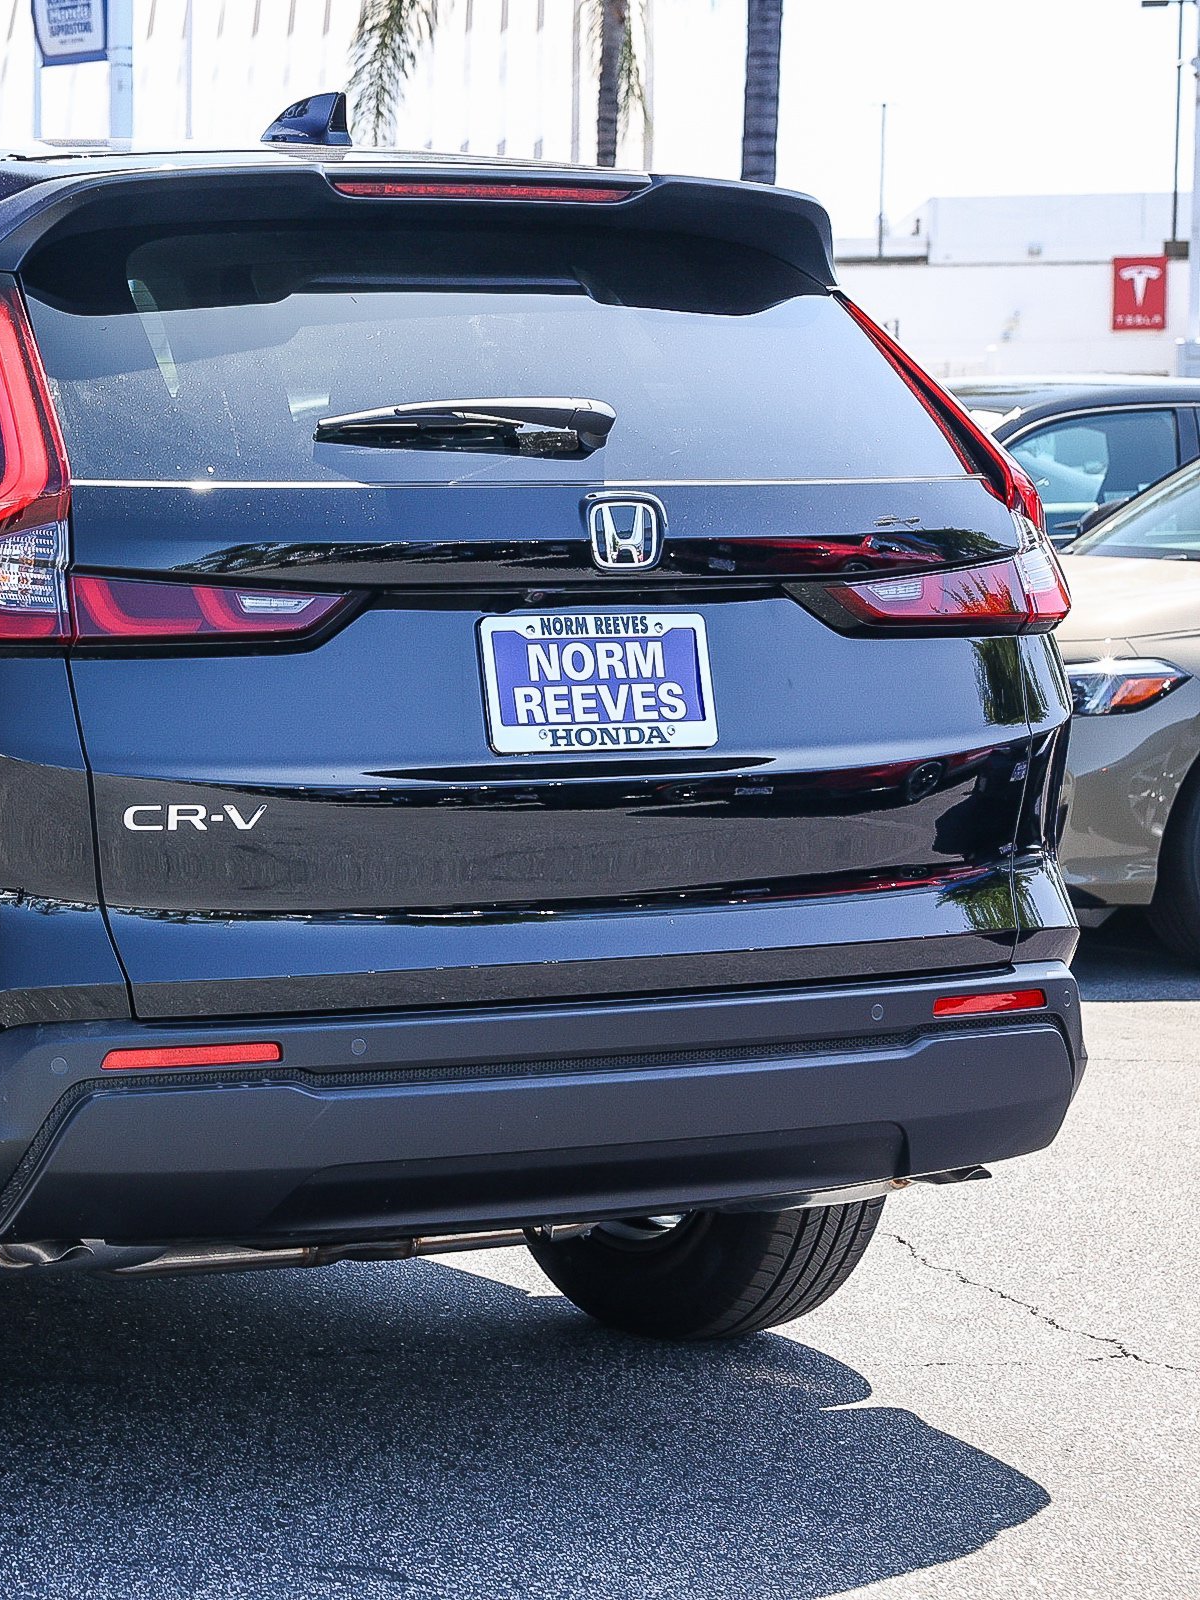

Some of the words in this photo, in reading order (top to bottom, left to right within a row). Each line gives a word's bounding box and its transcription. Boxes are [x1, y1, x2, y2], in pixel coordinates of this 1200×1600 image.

[539, 616, 589, 636] NORM
[594, 615, 649, 635] REEVES
[526, 640, 666, 682] NORM
[513, 681, 688, 725] REEVES
[549, 726, 671, 747] HONDA
[123, 804, 268, 831] CR-V
